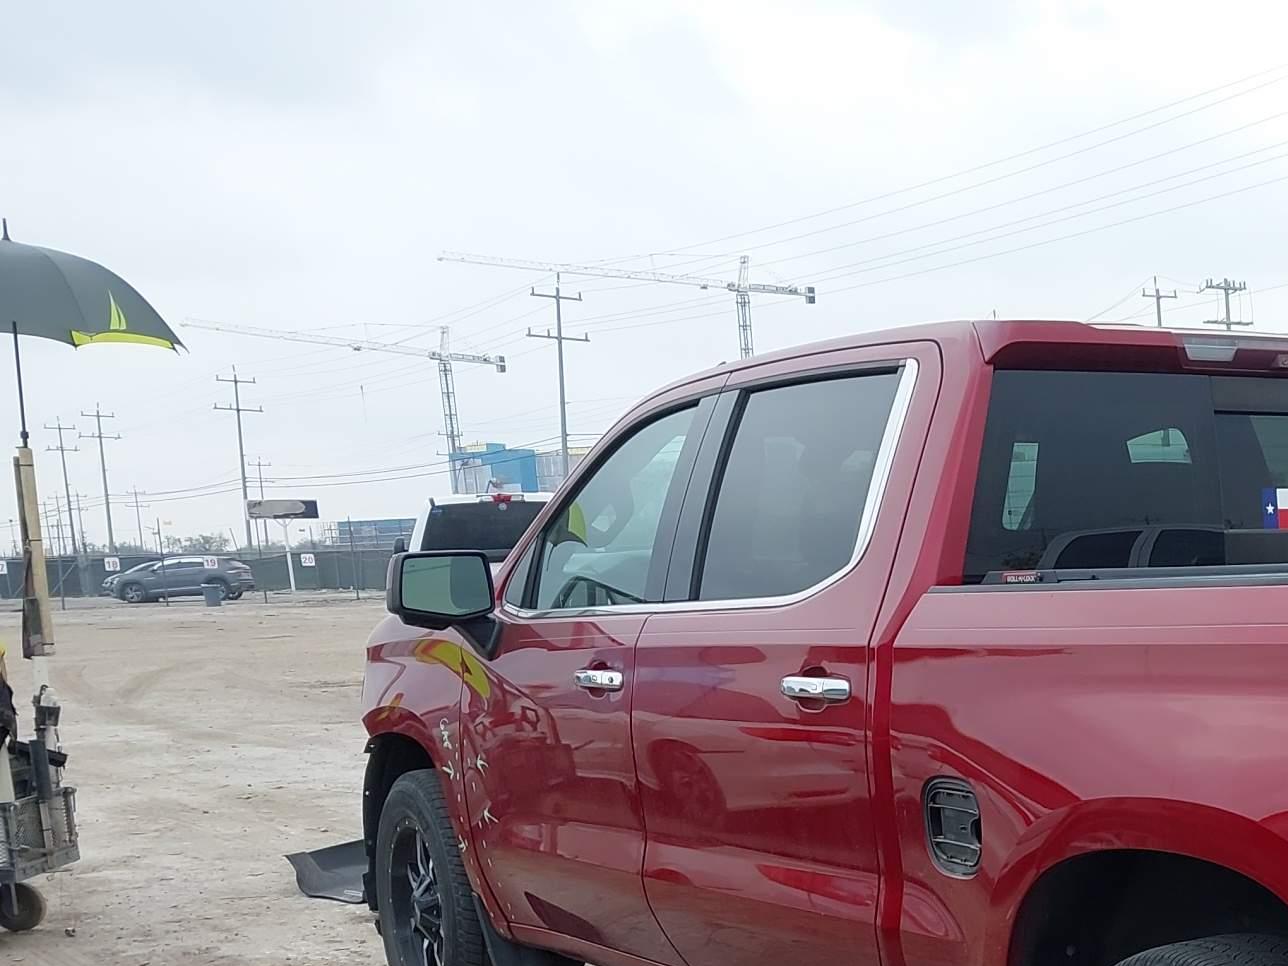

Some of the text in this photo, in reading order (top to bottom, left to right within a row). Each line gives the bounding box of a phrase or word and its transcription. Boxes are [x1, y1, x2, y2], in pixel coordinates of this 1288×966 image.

[206, 559, 216, 567] 19
[302, 555, 313, 564] 20
[106, 560, 119, 570] 18
